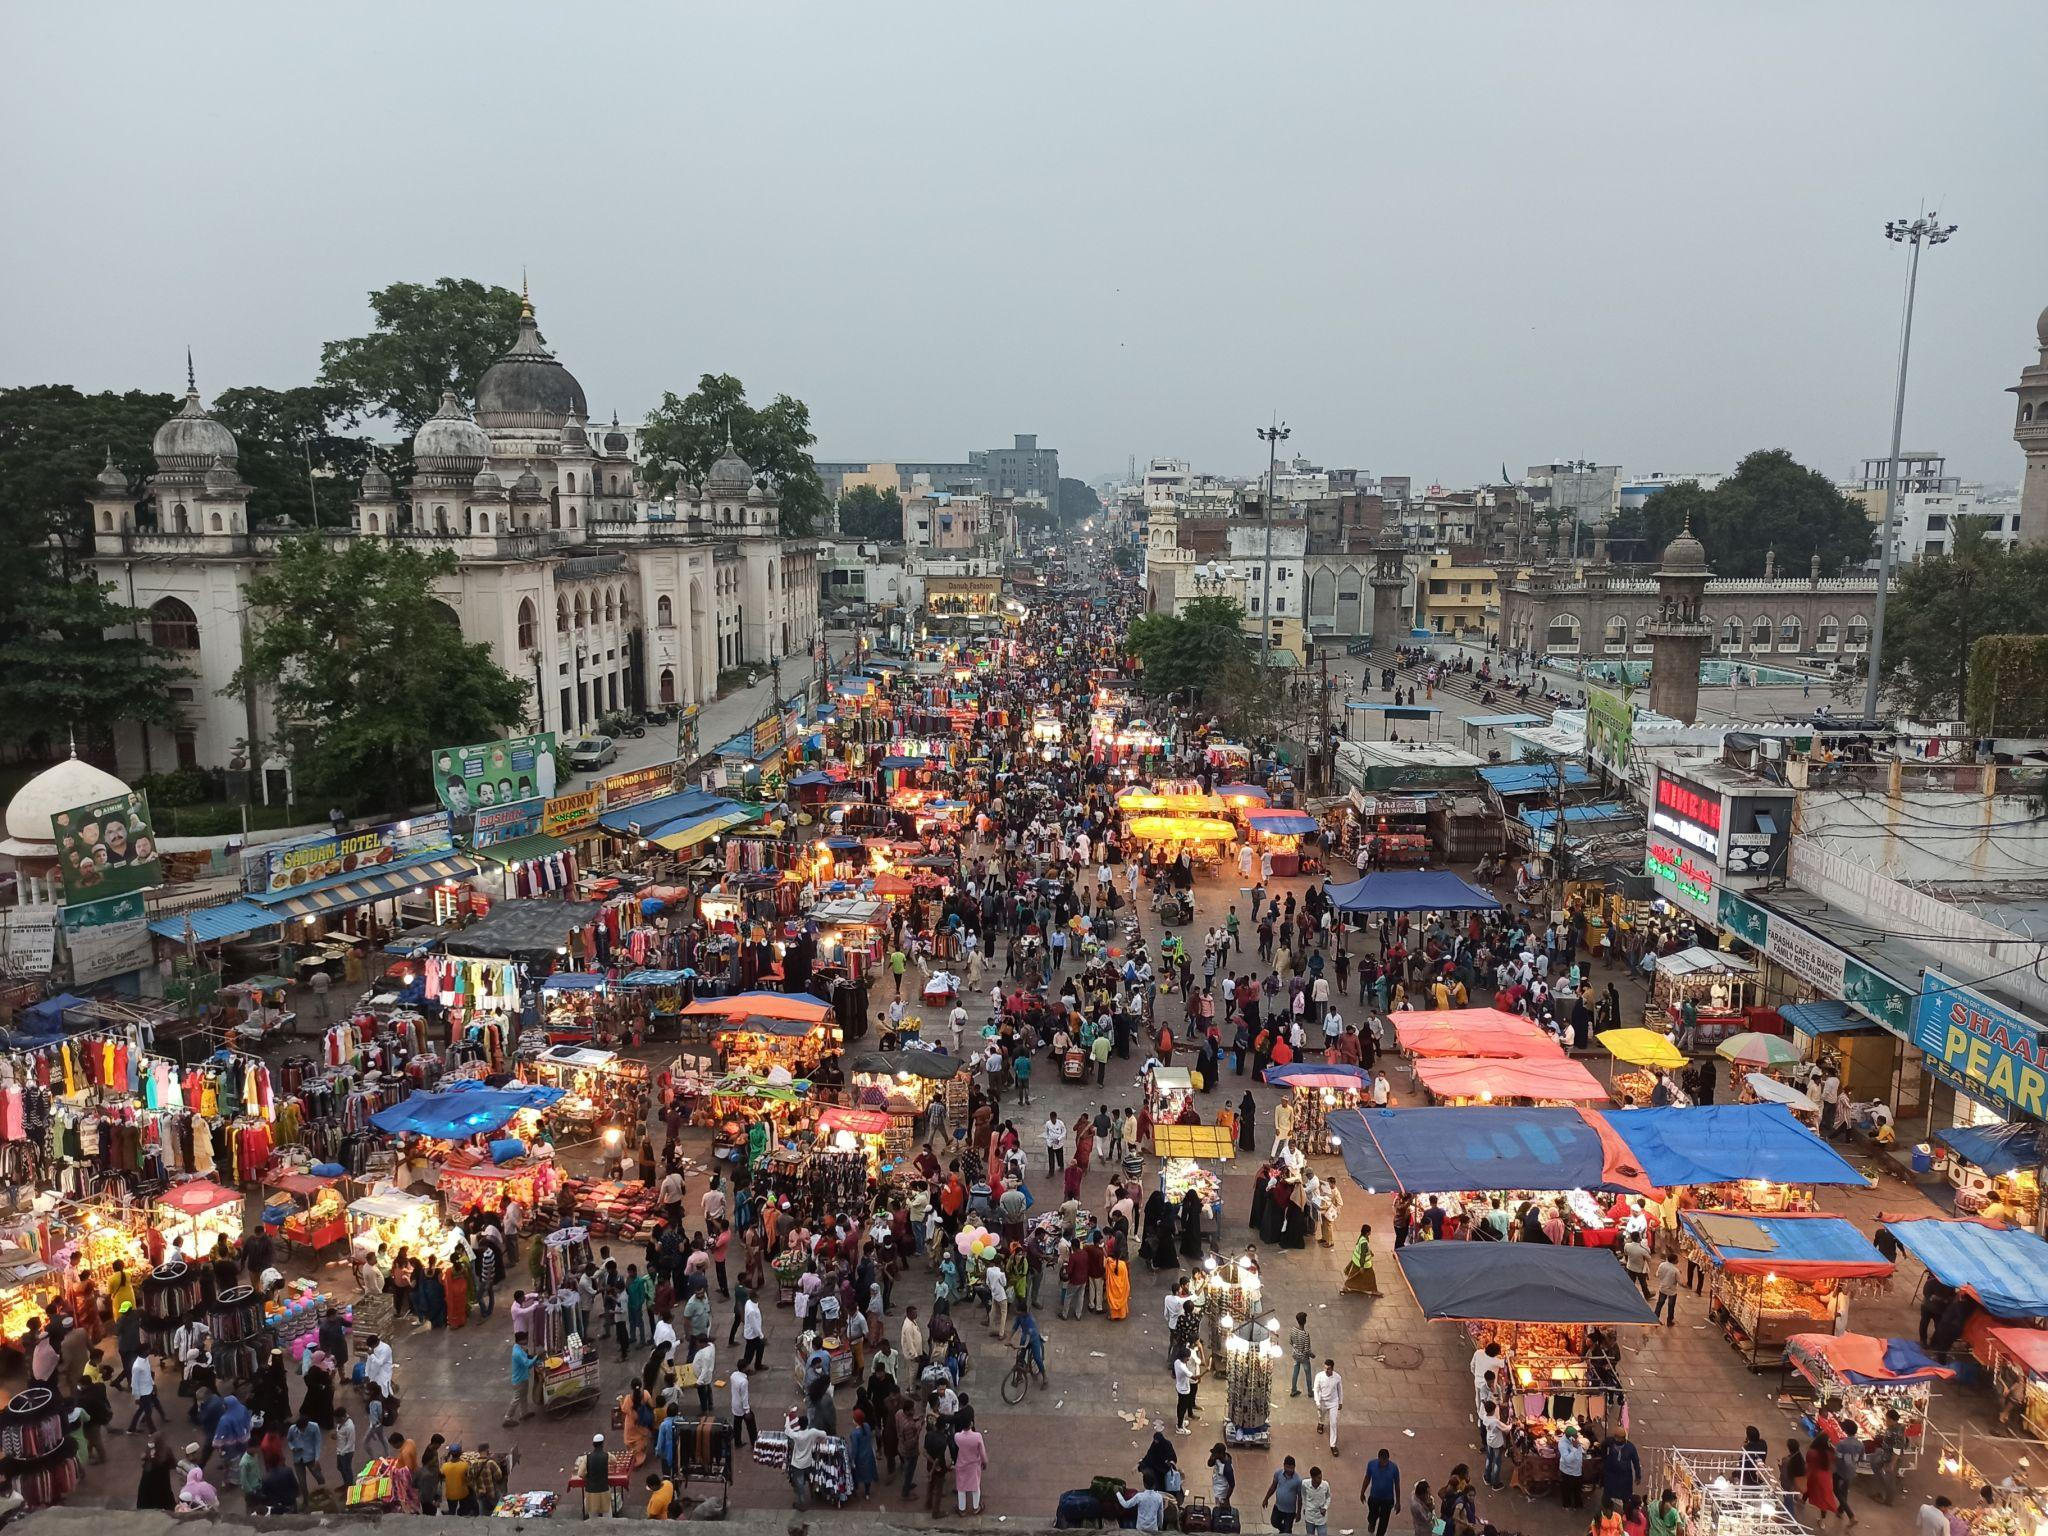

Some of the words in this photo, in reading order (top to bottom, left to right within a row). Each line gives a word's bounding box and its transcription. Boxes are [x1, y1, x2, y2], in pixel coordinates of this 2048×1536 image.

[970, 582, 994, 590] Fashion
[606, 773, 648, 792] MUQADDAR
[1376, 801, 1396, 809] TAJ
[284, 843, 337, 870] SADDAM
[340, 833, 381, 857] HOTEL
[1822, 849, 1868, 897] FARASHA
[1869, 871, 1897, 914] CAFE
[1910, 898, 1964, 938] BAKERY
[1767, 929, 1794, 955] FARASHA
[1794, 942, 1811, 962] CAFE
[1810, 954, 1817, 964] &
[1816, 956, 1843, 977] BAKERY
[1773, 942, 1793, 963] FAMILY
[1793, 956, 1834, 987] RESTAURANT
[1926, 1053, 2006, 1109] PEARLS
[1943, 1024, 2048, 1121] PEAR
